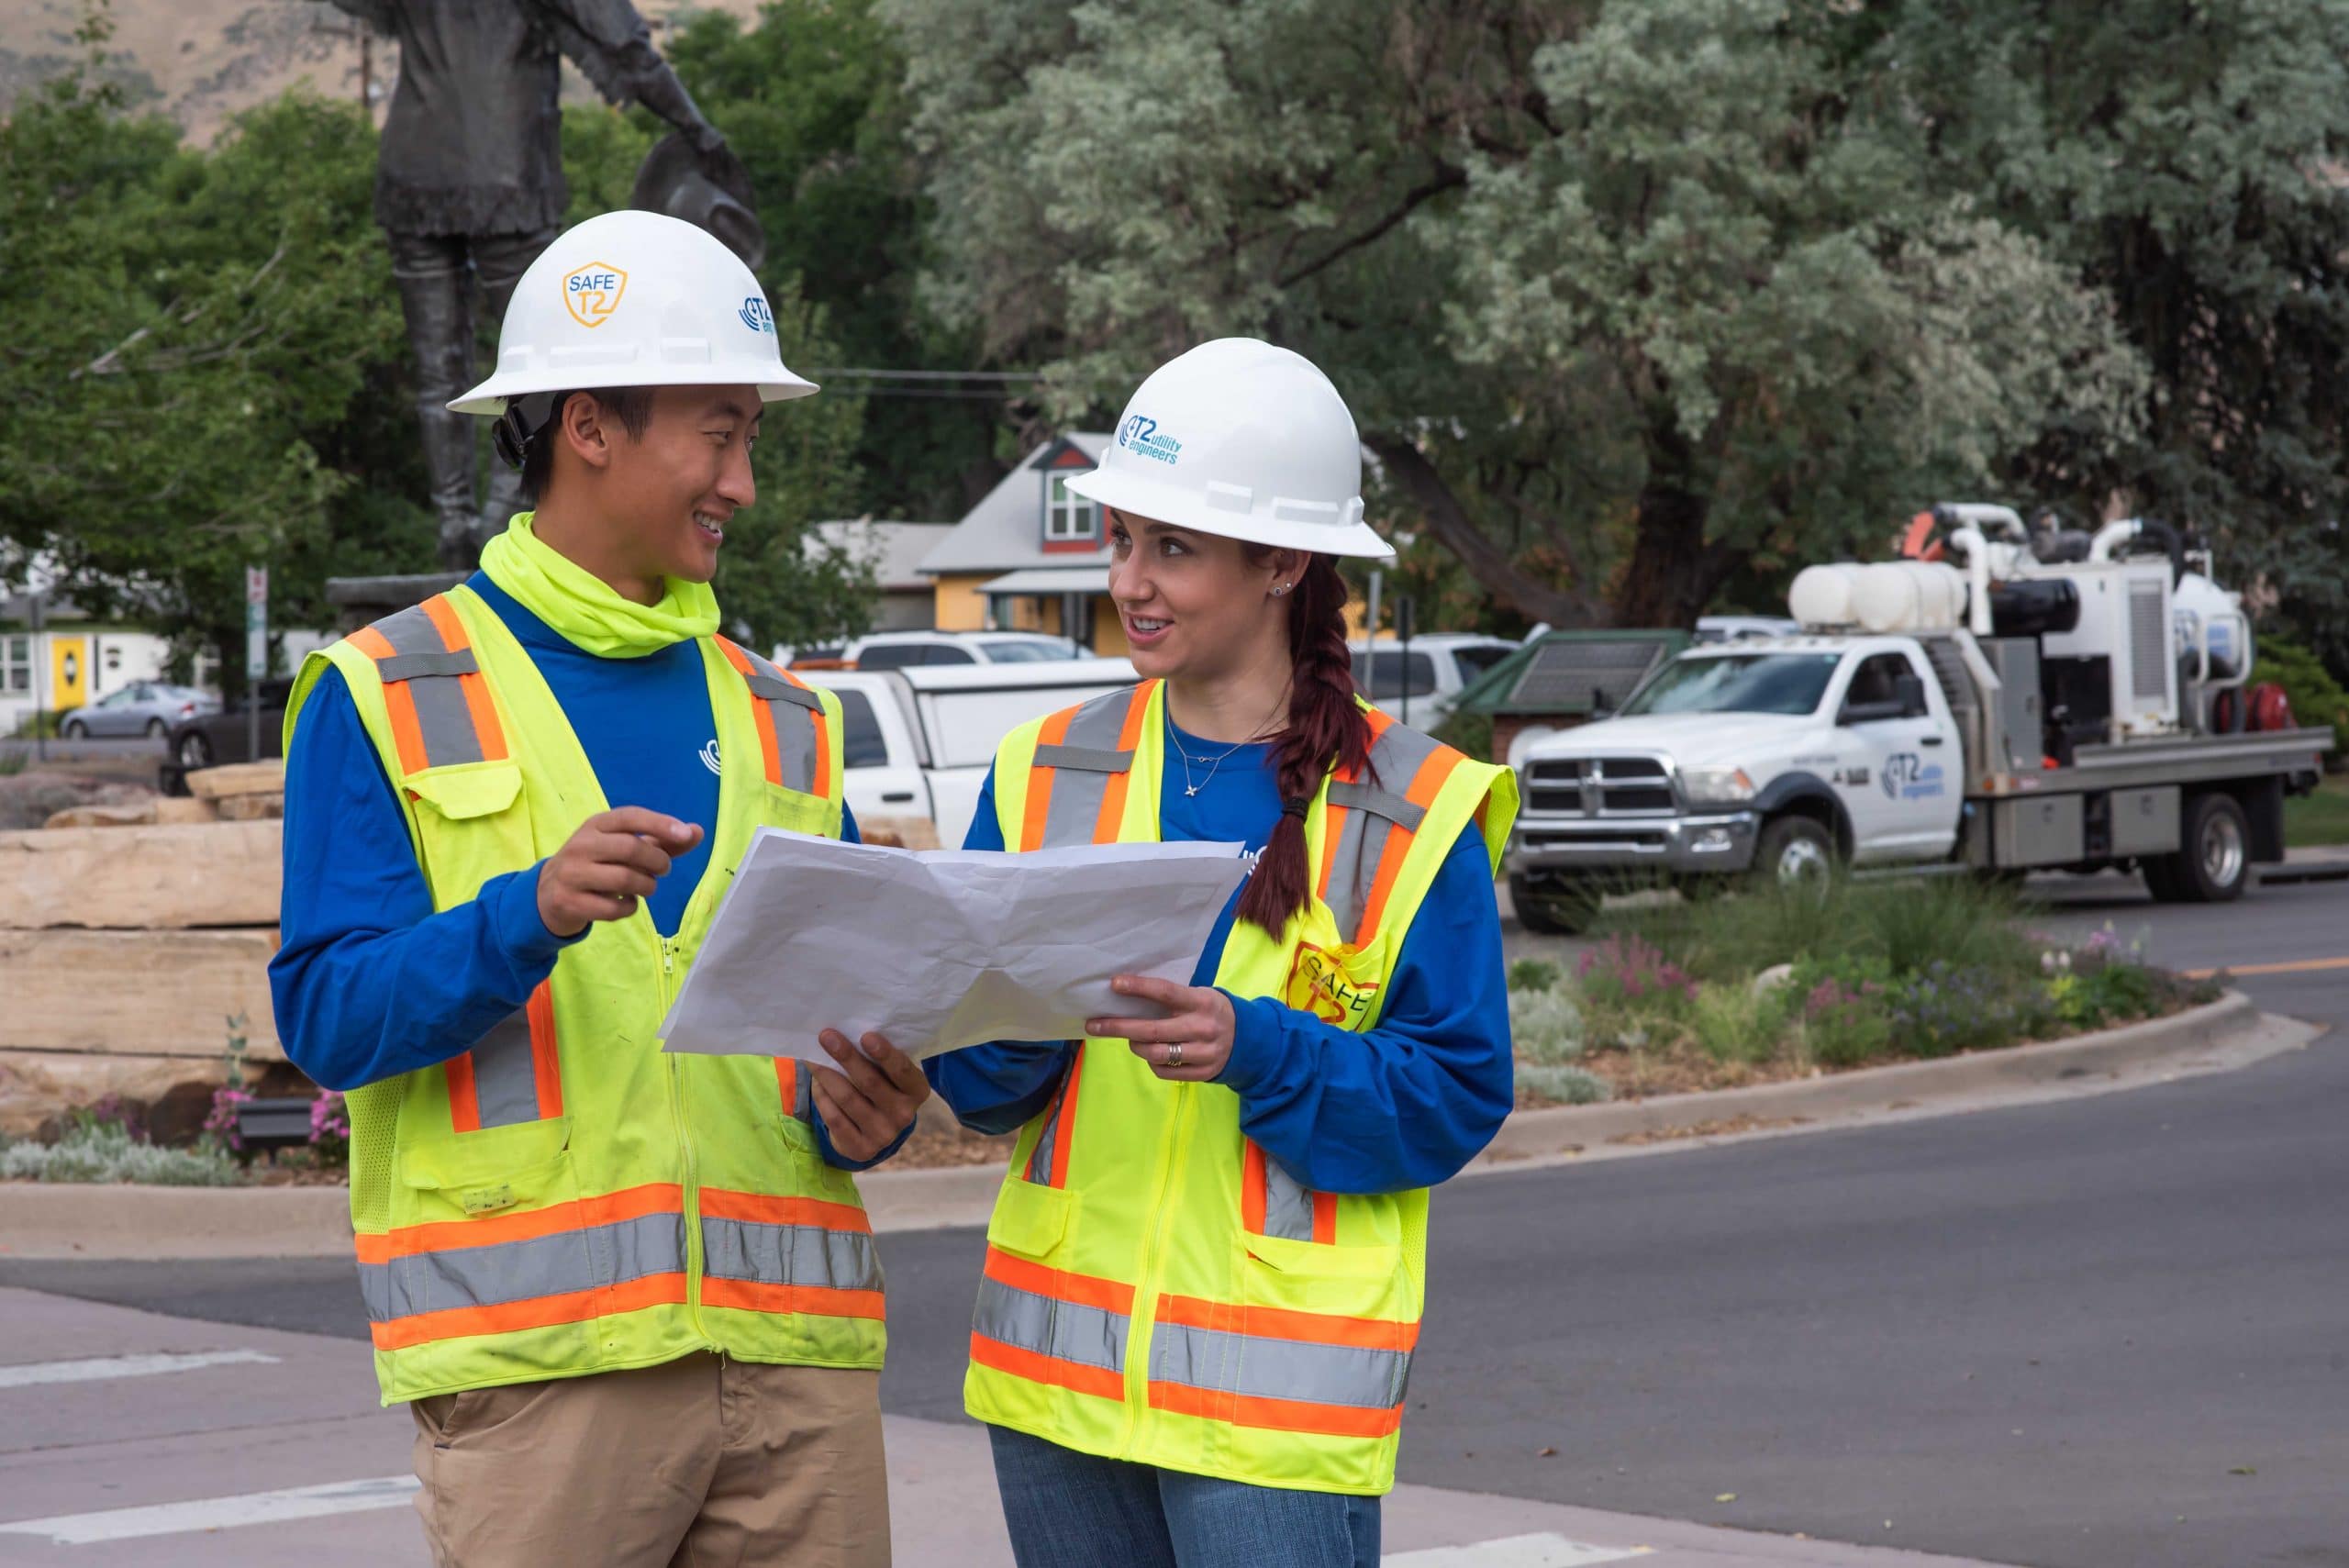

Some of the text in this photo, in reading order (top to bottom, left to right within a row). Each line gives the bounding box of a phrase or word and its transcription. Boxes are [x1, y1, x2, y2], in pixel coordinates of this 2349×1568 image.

[570, 274, 615, 291] SAFE
[577, 291, 612, 314] T2
[1134, 416, 1182, 452] T2 utility
[1129, 440, 1177, 464] engineers
[1896, 752, 1920, 781] T2
[1304, 956, 1372, 1011] SAFE
